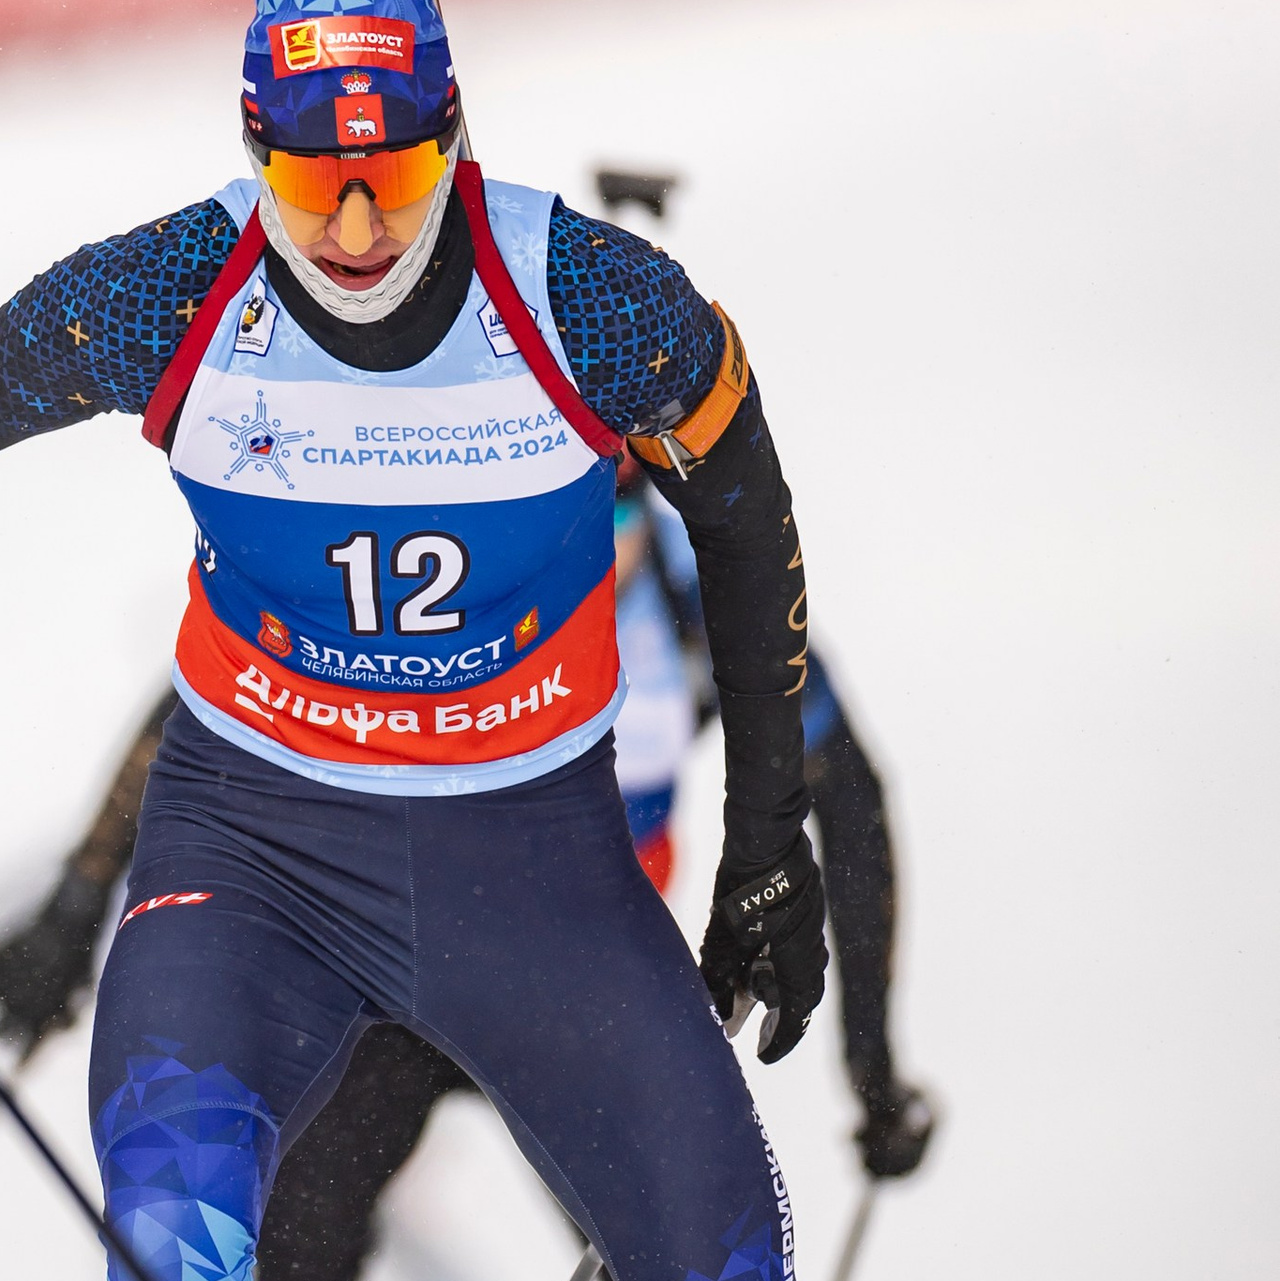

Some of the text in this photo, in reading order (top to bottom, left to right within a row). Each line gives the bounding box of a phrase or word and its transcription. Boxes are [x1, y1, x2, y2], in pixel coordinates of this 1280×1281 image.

[326, 32, 404, 47] ЗЛАТОУСТ
[354, 407, 563, 443] ВСЕРОССИЙСКАЯ
[302, 430, 569, 467] СПАРТАКИАДА 2024
[326, 531, 470, 636] 12
[298, 635, 508, 678] ЗЛАТОУСТ
[301, 658, 504, 688] ЧЕЛЯБИНСКАЯ ОБЛАСТЬ
[434, 662, 573, 735] Банк
[740, 877, 790, 912] MOAX
